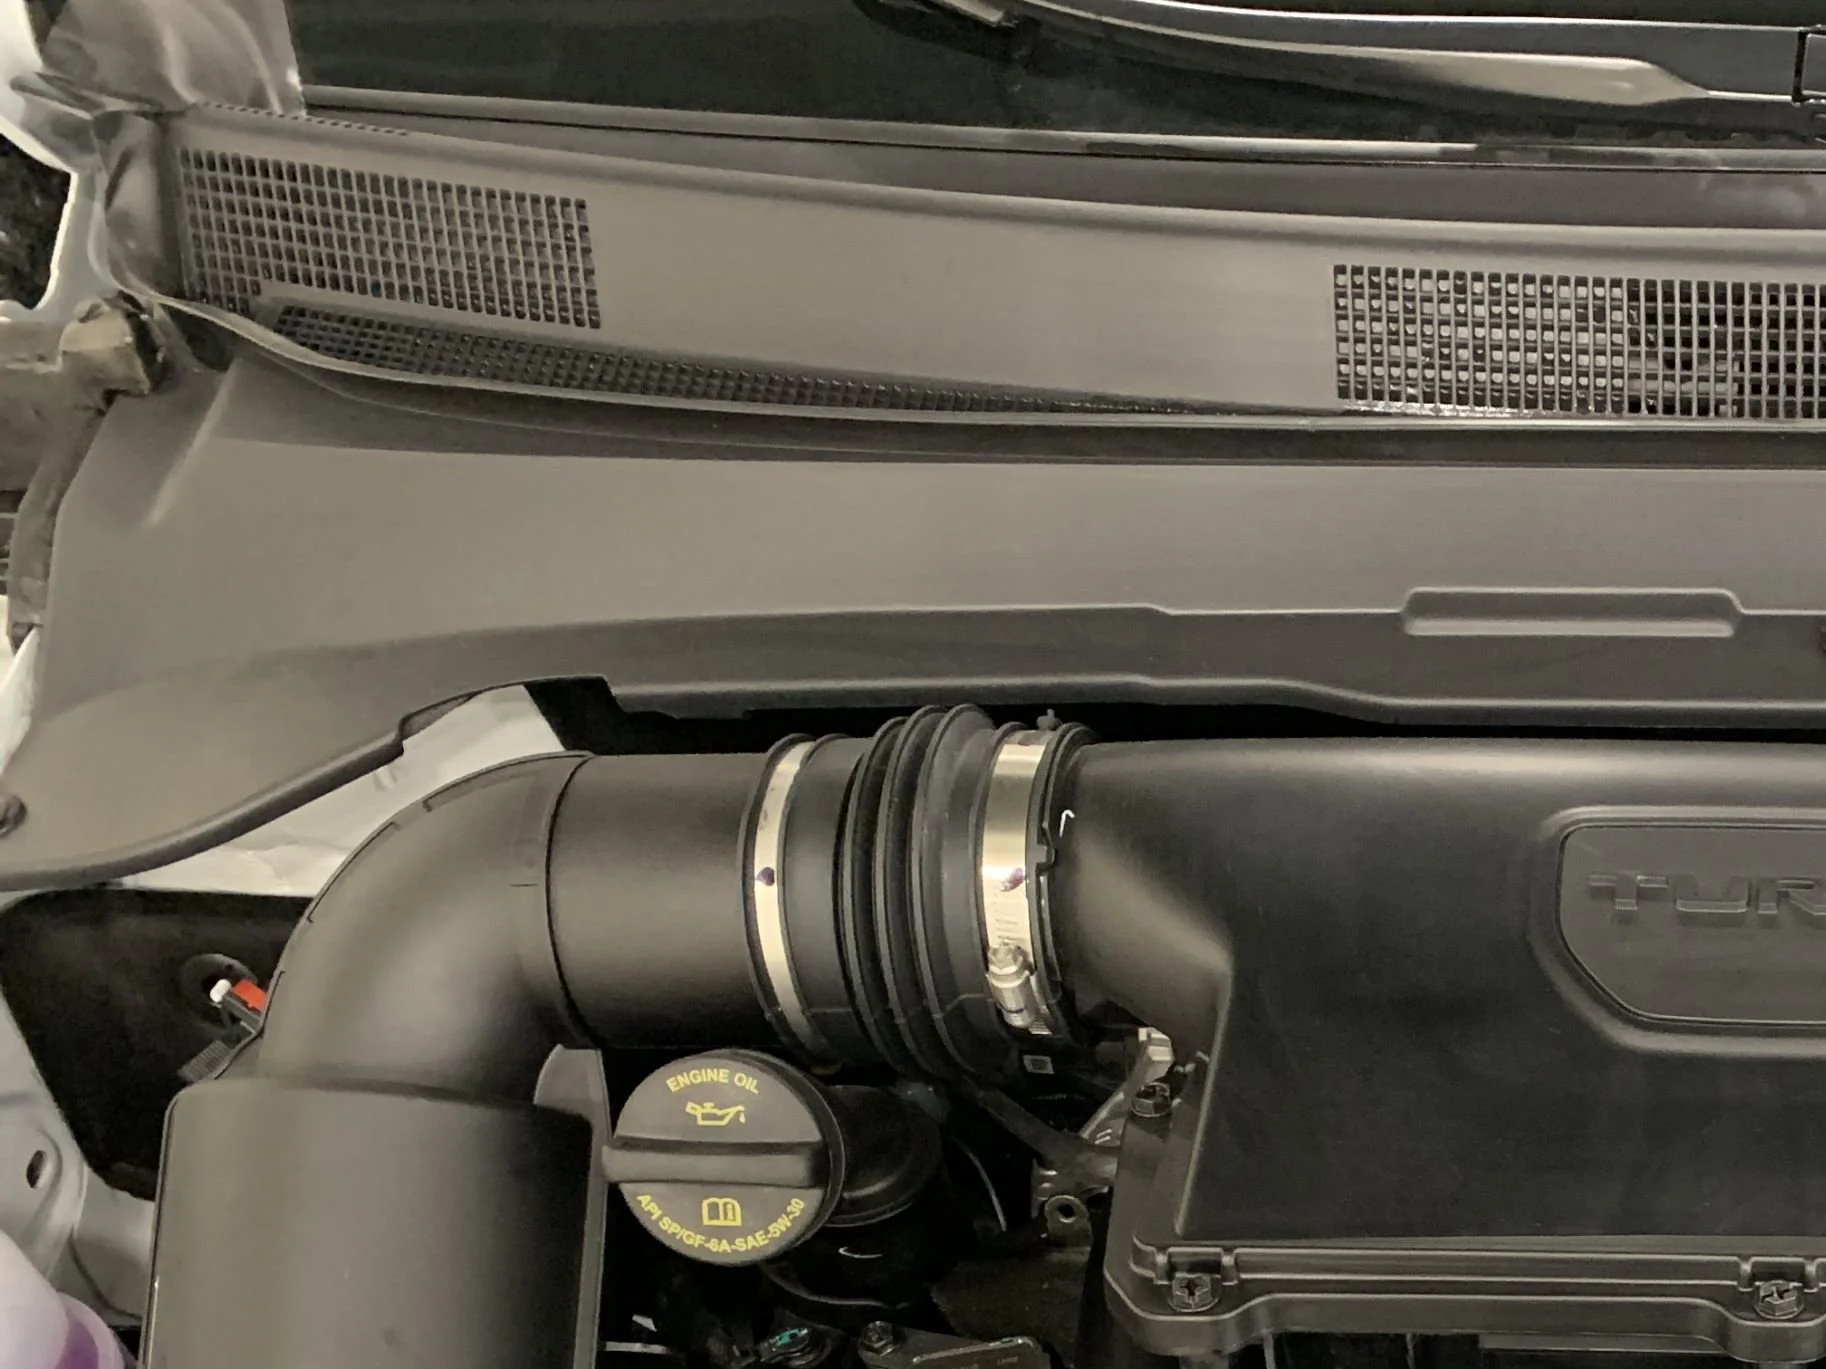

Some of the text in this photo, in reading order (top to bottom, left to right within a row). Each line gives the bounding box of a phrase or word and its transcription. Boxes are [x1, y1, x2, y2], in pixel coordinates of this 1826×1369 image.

[665, 1068, 760, 1095] ENGINE OIL
[636, 1194, 662, 1220] API
